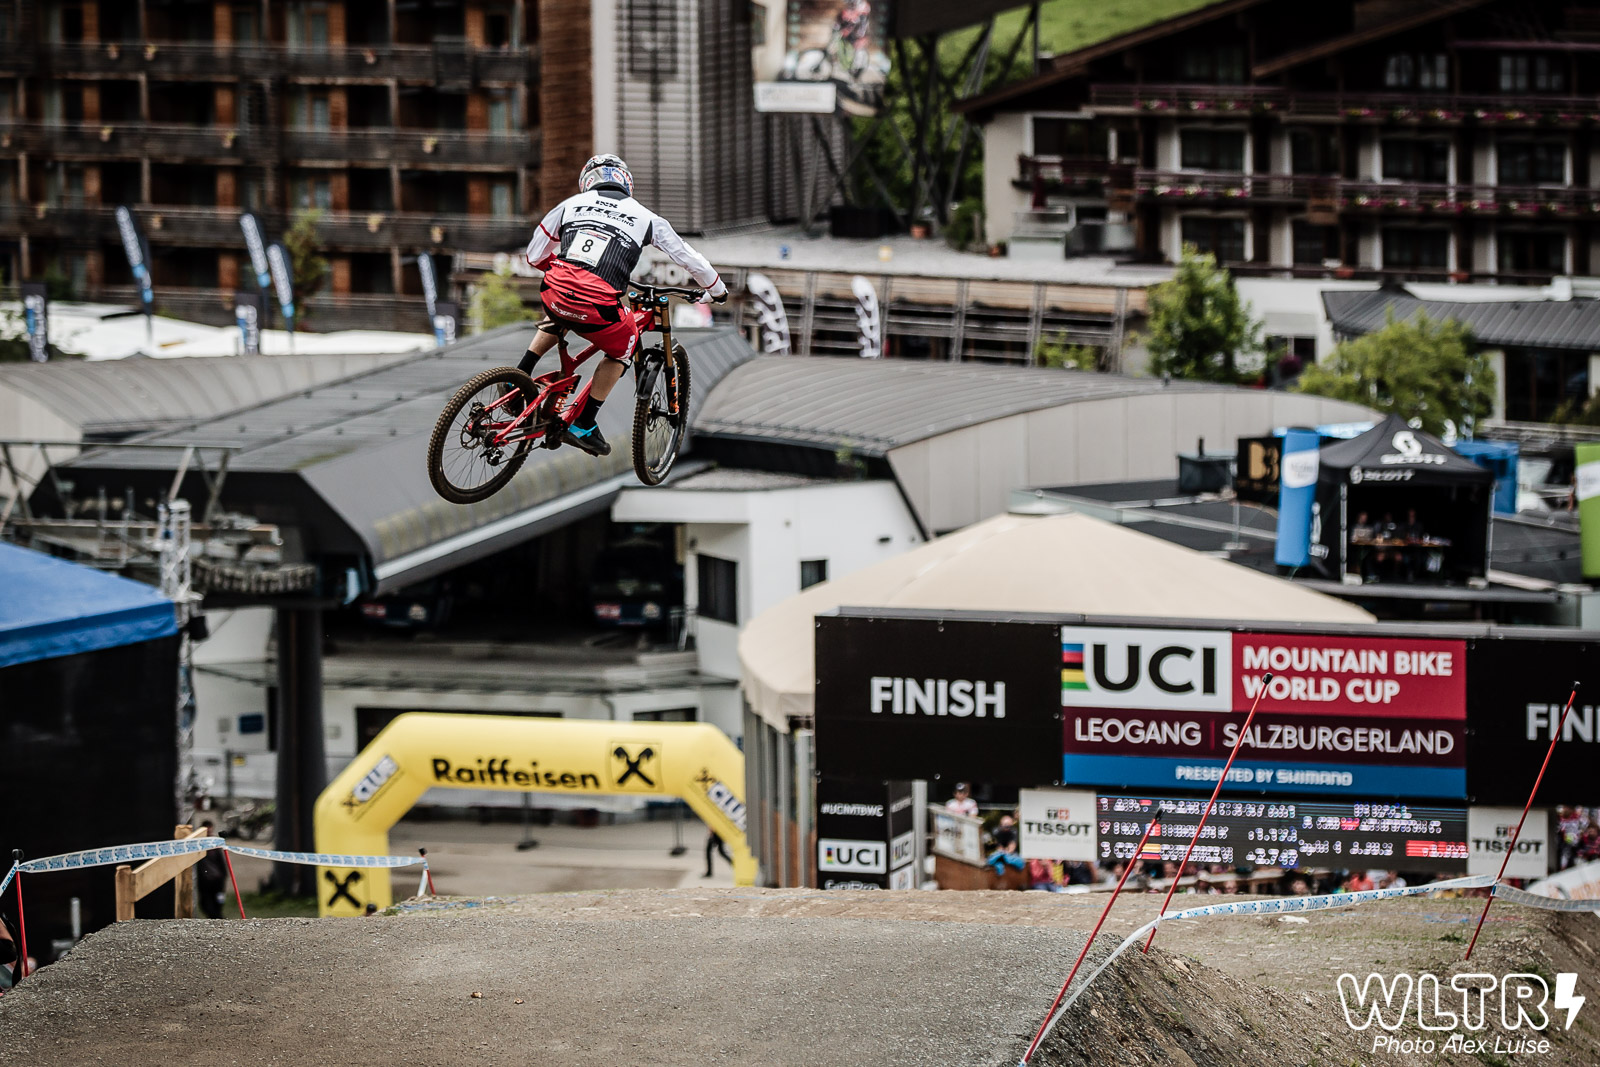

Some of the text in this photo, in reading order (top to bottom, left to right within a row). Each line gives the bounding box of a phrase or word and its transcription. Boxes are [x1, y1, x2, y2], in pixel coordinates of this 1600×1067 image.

[573, 205, 638, 222] TREK
[582, 239, 593, 252] 8
[1092, 643, 1218, 697] UCI
[1242, 646, 1453, 678] MOUNTAIN BIKE
[870, 676, 1006, 718] FINISH
[1242, 676, 1401, 705] WORLD CUP
[1075, 717, 1455, 756] LEOGANG SALZBURGERLAND
[431, 759, 601, 789] Raiffeisen
[1175, 766, 1254, 785] PRESENTED
[1256, 769, 1273, 785] BY
[1024, 822, 1091, 836] TISSOT
[836, 847, 879, 867] UCI
[1472, 840, 1543, 855] TISSOT
